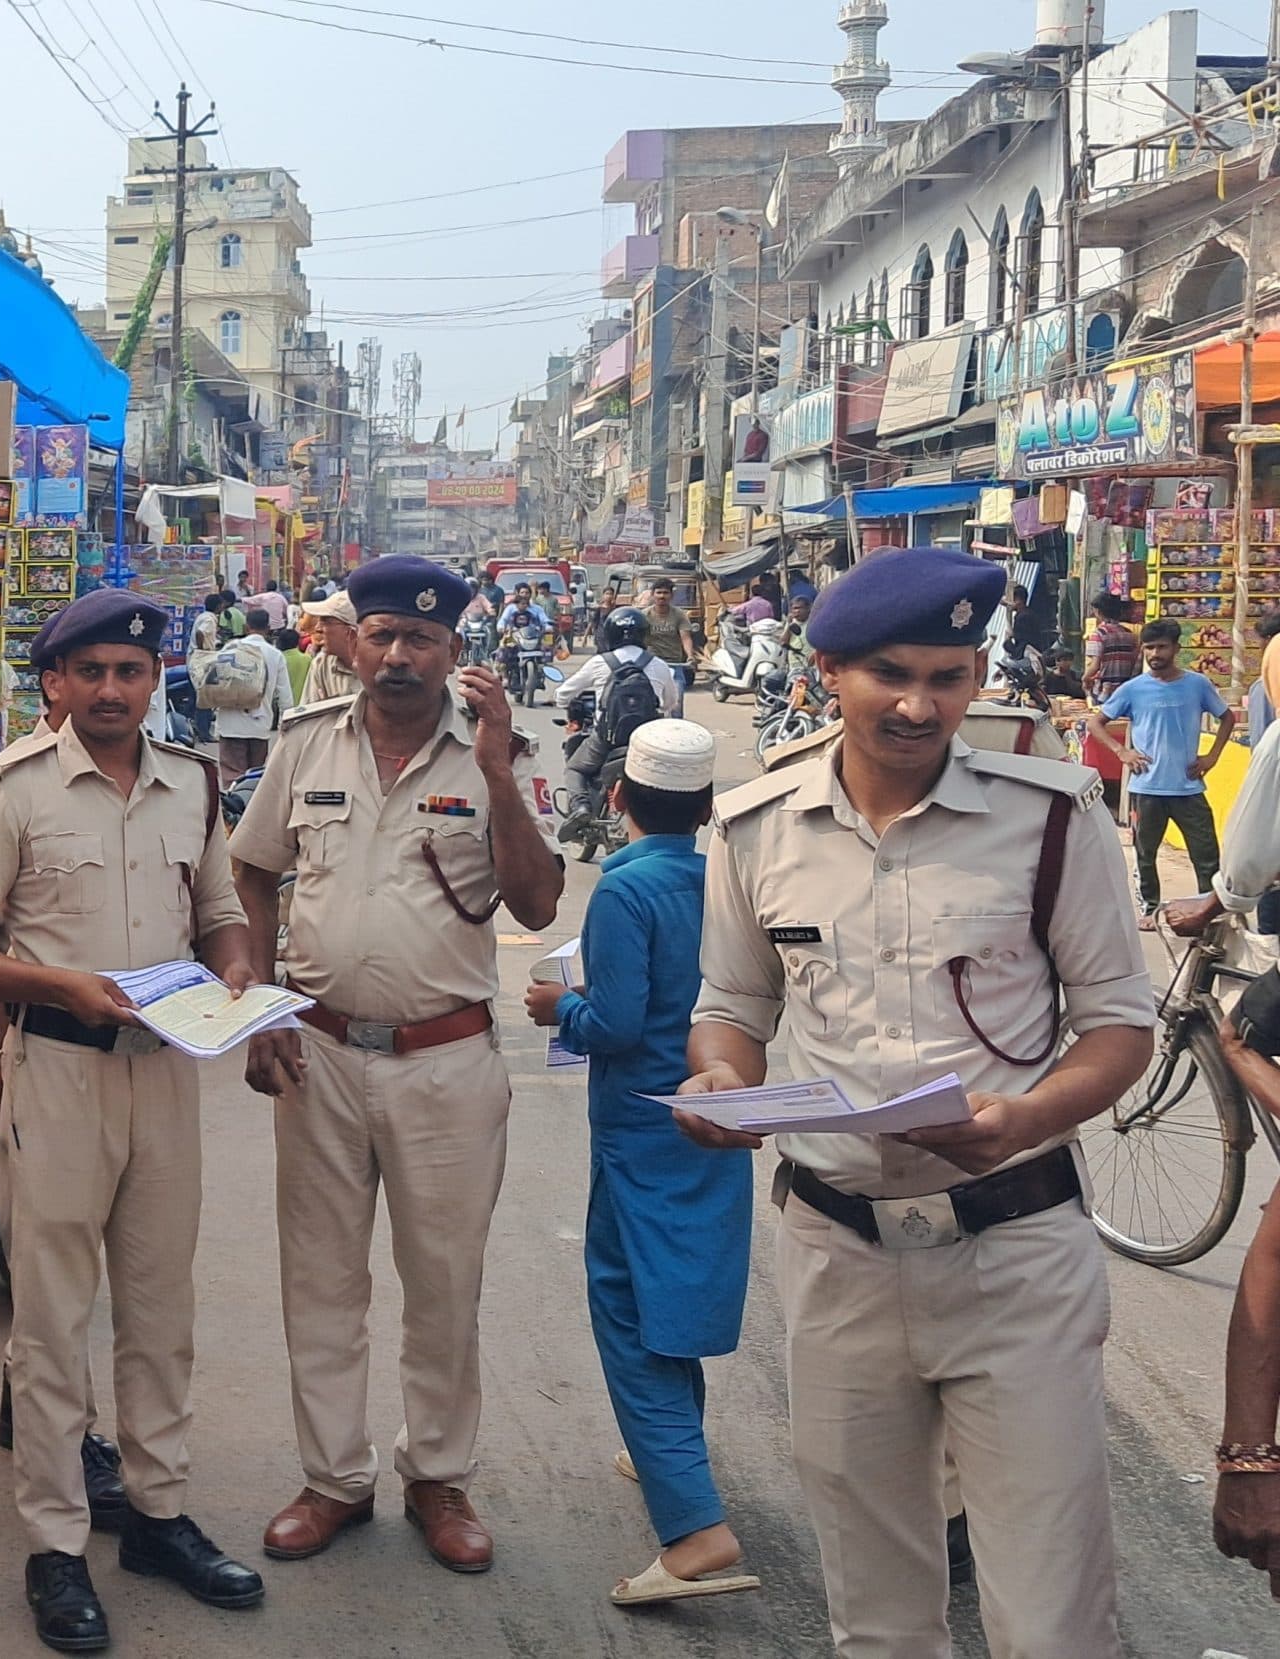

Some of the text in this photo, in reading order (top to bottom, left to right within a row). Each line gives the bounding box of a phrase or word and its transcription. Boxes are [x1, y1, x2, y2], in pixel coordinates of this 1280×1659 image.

[1019, 390, 1051, 451] A
[1055, 397, 1100, 446] to
[1105, 368, 1140, 438] Z
